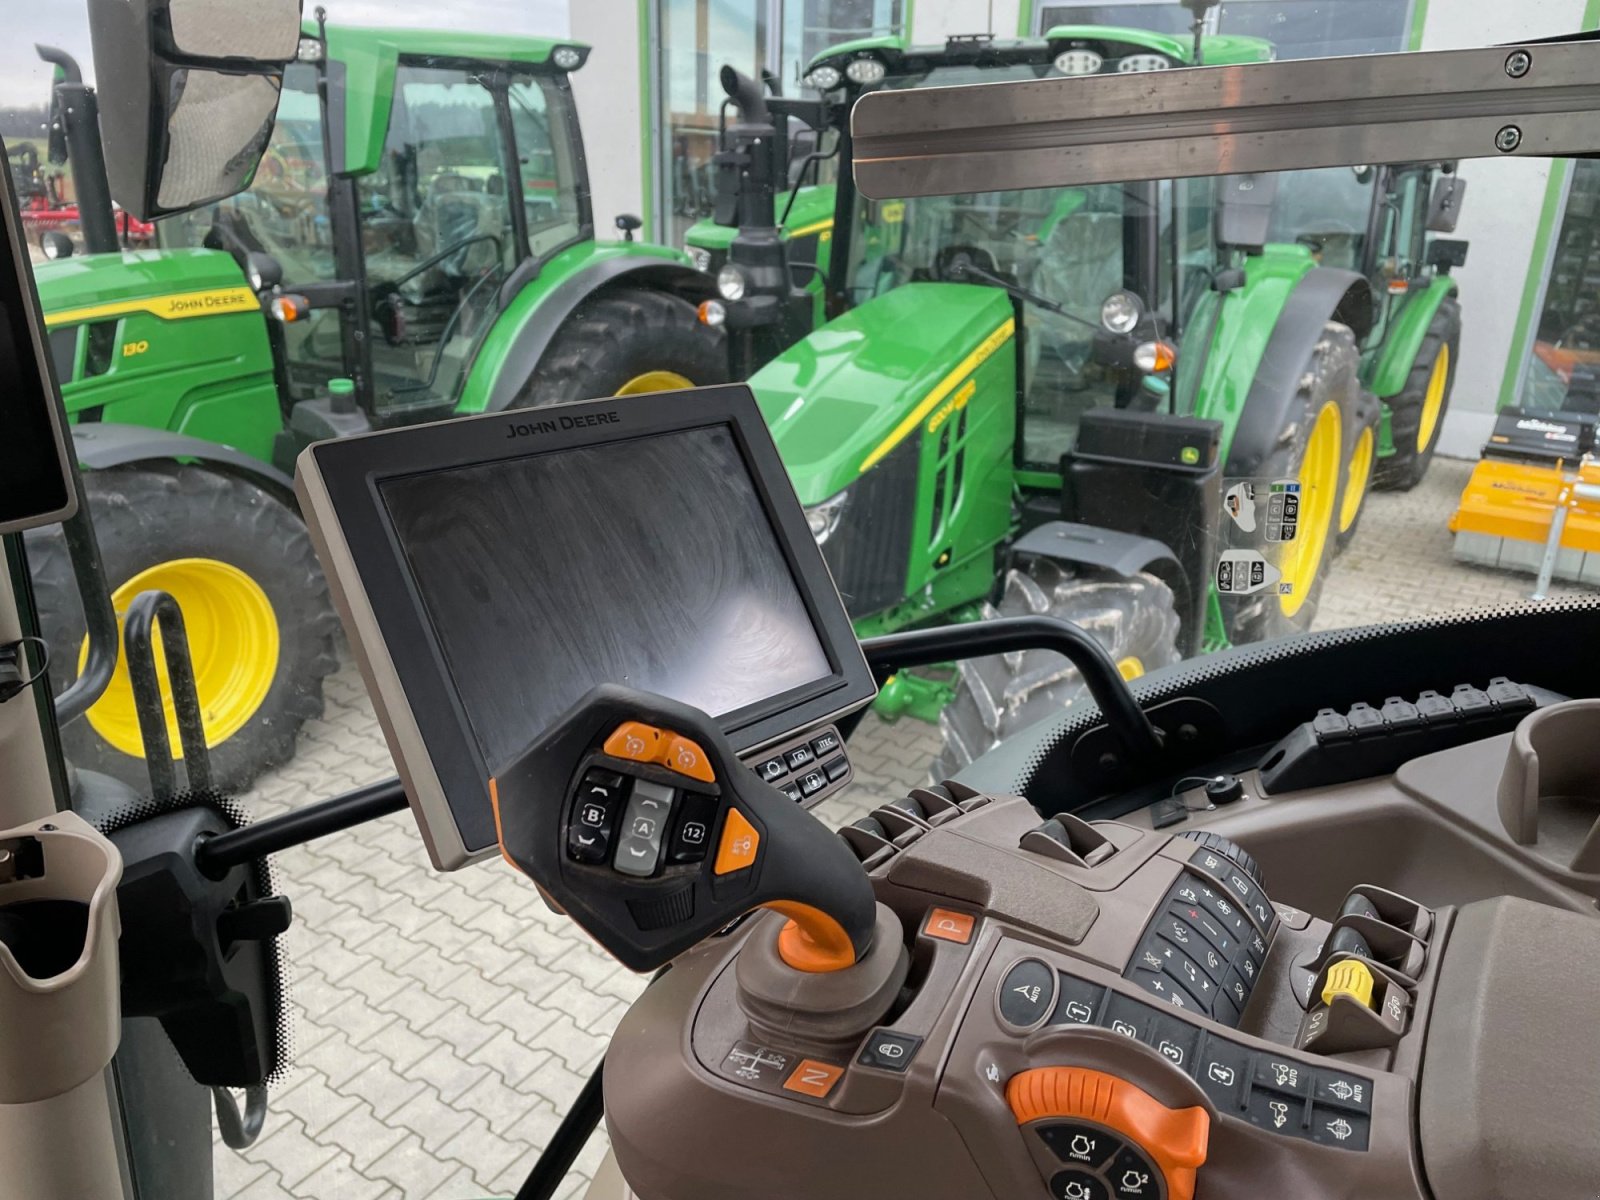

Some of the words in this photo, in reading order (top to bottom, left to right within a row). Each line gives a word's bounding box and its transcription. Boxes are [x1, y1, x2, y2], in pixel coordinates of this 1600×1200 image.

[168, 298, 203, 312] JOHN
[205, 293, 246, 307] DEERE
[506, 420, 557, 439] JOHN
[558, 411, 620, 430] DEERE
[587, 809, 599, 822] B
[638, 822, 649, 834] A
[686, 827, 700, 838] 12
[937, 918, 961, 933] P
[1030, 986, 1041, 1004] AUTO
[1072, 1006, 1086, 1016] 1
[1116, 1025, 1132, 1036] 2
[1163, 1047, 1179, 1059] 3
[801, 1068, 830, 1087] N
[1213, 1068, 1230, 1080] 4
[1288, 1068, 1298, 1087] AUTO
[1353, 1084, 1363, 1103] AUTO
[1090, 1140, 1096, 1150] 1
[1141, 1174, 1149, 1184] 2
